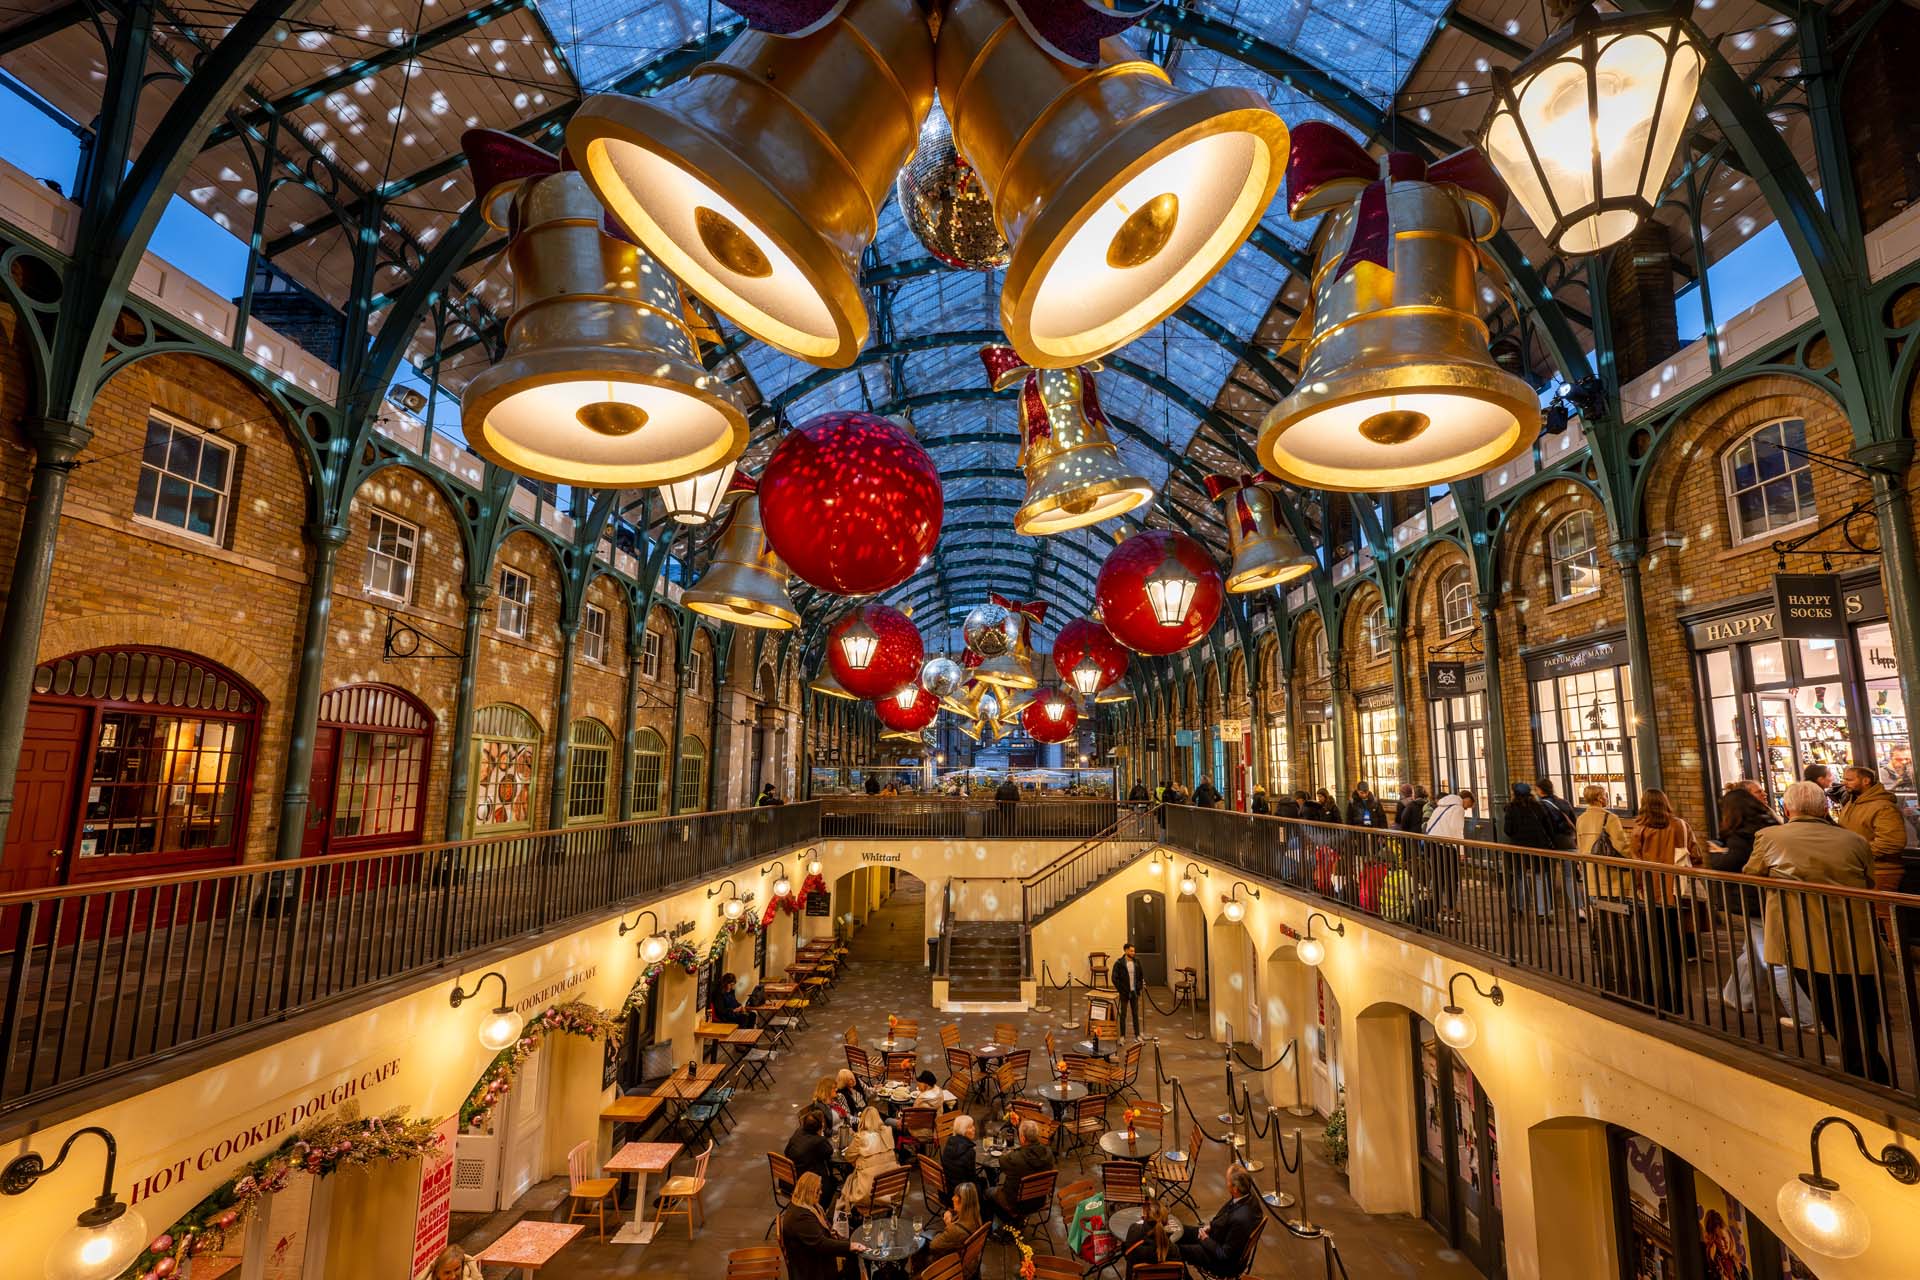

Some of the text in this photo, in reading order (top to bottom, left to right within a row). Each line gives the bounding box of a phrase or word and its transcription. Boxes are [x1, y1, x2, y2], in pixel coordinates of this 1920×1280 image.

[1789, 595, 1830, 605] HAPPY
[1790, 608, 1833, 618] SOCKS
[1706, 613, 1776, 642] HAPPY
[1544, 654, 1575, 667] PARFUMS
[1588, 646, 1614, 657] MARLY
[1869, 648, 1896, 669] Happy
[862, 852, 901, 862] Whittard
[516, 985, 550, 1013] COOKIE
[551, 974, 578, 997] DOUGH
[130, 1058, 401, 1206] HOT COOKIE DOUGH CAFE
[422, 1161, 453, 1194] HOT
[417, 1199, 450, 1233] ICE CREAM
